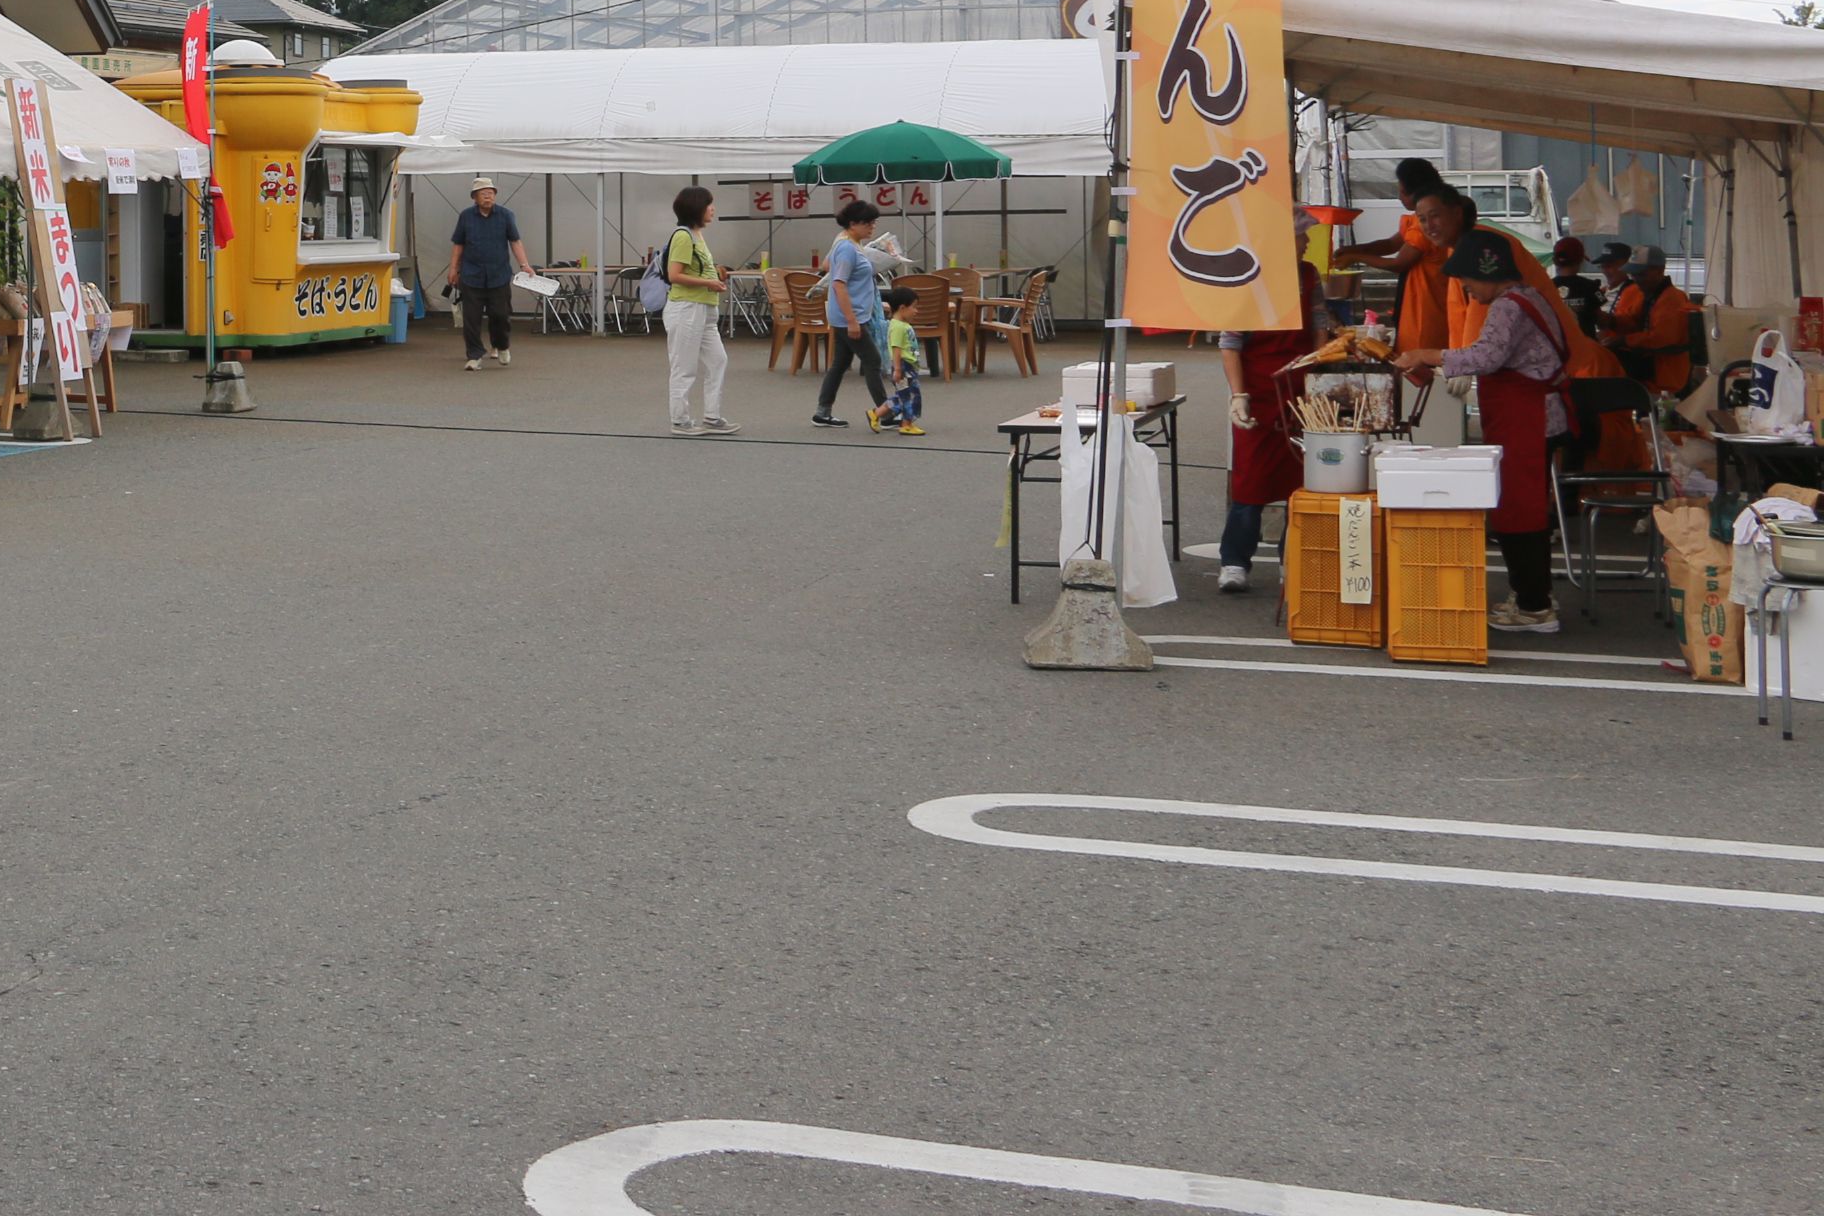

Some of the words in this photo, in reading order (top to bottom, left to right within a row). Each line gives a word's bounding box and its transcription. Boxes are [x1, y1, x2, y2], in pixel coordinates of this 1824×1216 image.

[185, 37, 199, 82] 新
[753, 189, 809, 212] そば
[838, 185, 929, 208] うどん
[294, 272, 379, 318] そば・うどん
[1345, 575, 1371, 594] ¥100
